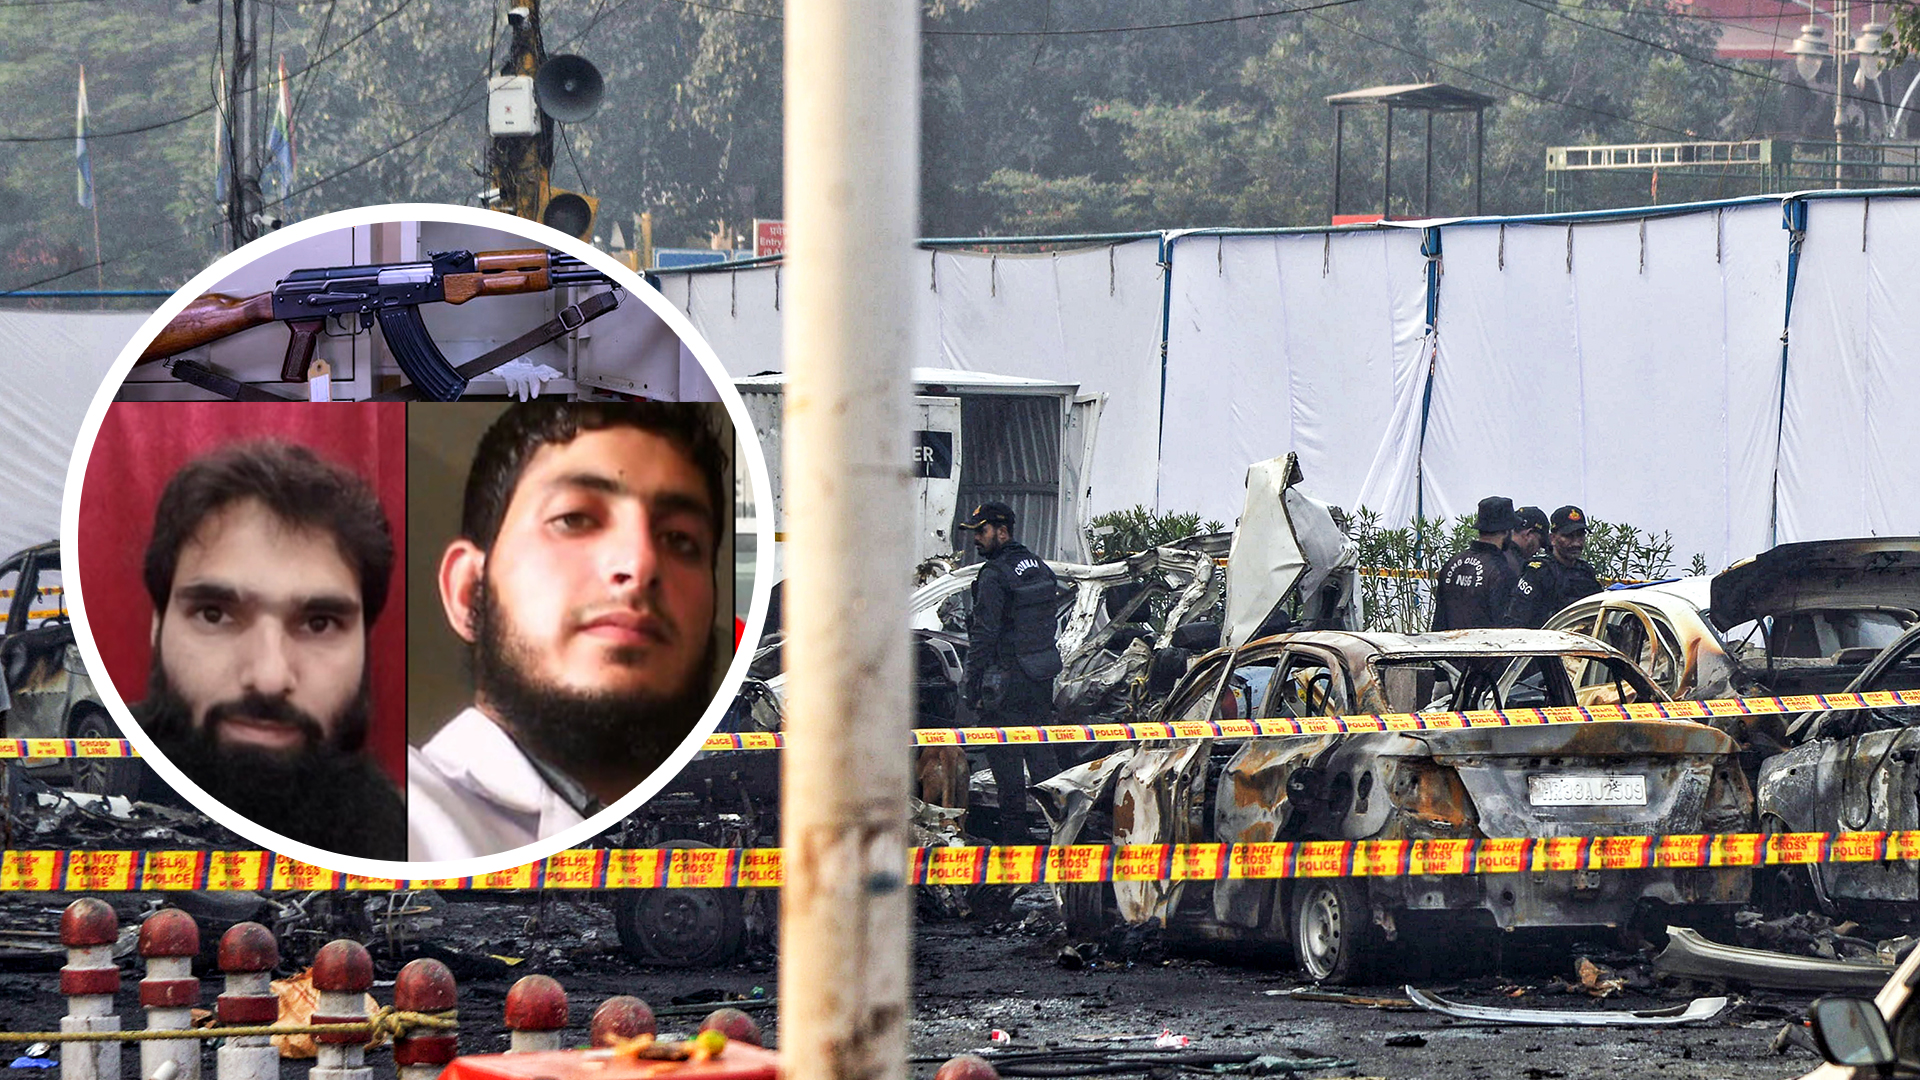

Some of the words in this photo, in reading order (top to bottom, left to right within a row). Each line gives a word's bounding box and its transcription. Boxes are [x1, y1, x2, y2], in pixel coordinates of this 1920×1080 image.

[760, 236, 782, 248] Entry
[1463, 556, 1484, 587] DISPOSAL
[1455, 574, 1473, 587] NSG
[1095, 728, 1124, 736] POLICE
[1222, 724, 1251, 732] POLICE
[1309, 724, 1328, 732] LINE
[926, 735, 945, 743] LINE
[966, 732, 996, 740] POLICE
[86, 747, 109, 755] LINE
[1233, 845, 1249, 854] DO
[1252, 845, 1276, 854] NOT
[1415, 842, 1429, 850] DO
[1434, 842, 1457, 850] NOT
[1771, 841, 1808, 850] CROSS
[672, 853, 688, 862] DO
[692, 852, 718, 862] NOT
[1049, 848, 1065, 858] DO
[1069, 848, 1093, 857] NOT
[1119, 849, 1154, 860] DELHI
[1415, 851, 1453, 860] CROSS
[1594, 847, 1631, 856] CROSS
[1657, 851, 1696, 863] POLICE
[1778, 850, 1803, 861] LINE
[1833, 846, 1872, 857] POLICE
[71, 854, 88, 864] DO
[93, 854, 119, 864] NOT
[150, 857, 188, 868] DELHI
[551, 856, 588, 867] DELHI
[744, 855, 781, 866] DELHI
[933, 852, 969, 864] DELHI
[1051, 858, 1089, 868] CROSS
[1235, 854, 1272, 865] CROSS
[1478, 855, 1518, 867] POLICE
[1601, 857, 1625, 868] LINE
[74, 865, 116, 876] CROSS
[279, 865, 321, 876] CROSS
[674, 864, 713, 873] CROSS
[1115, 863, 1156, 875] POLICE
[1241, 865, 1266, 876] LINE
[1298, 860, 1338, 871] POLICE
[1422, 861, 1447, 872] LINE
[145, 873, 191, 884] POLICE
[547, 871, 590, 883] POLICE
[740, 870, 783, 880] POLICE
[930, 867, 971, 879] POLICE
[1057, 869, 1083, 880] LINE
[80, 877, 109, 888] LINE
[286, 877, 314, 887] LINE
[486, 876, 514, 887] LINE
[680, 874, 707, 885] LINE
